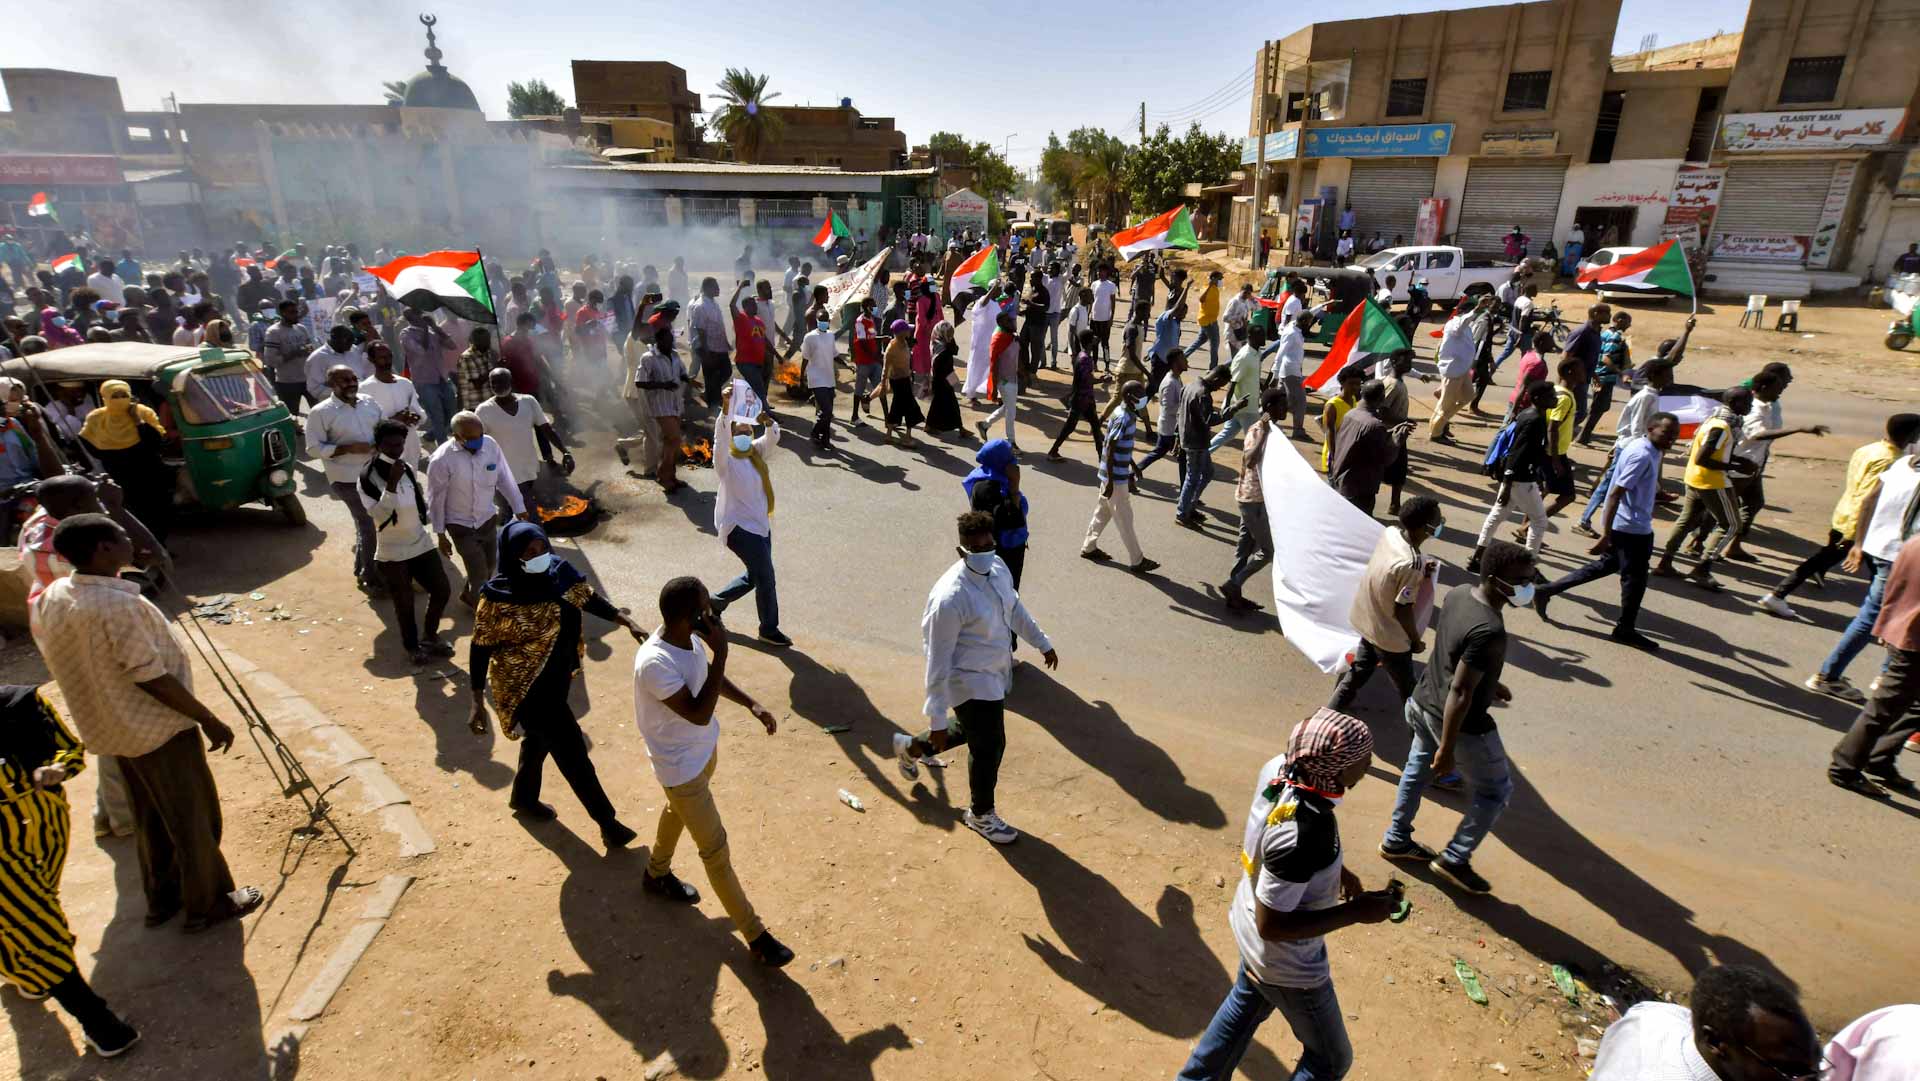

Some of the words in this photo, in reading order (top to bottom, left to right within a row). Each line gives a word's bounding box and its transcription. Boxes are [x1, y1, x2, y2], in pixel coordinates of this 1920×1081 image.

[1382, 128, 1420, 144] أسواق
[1746, 123, 1794, 141] جلابية
[1796, 125, 1831, 139] مان
[1834, 121, 1885, 140] كلاسي
